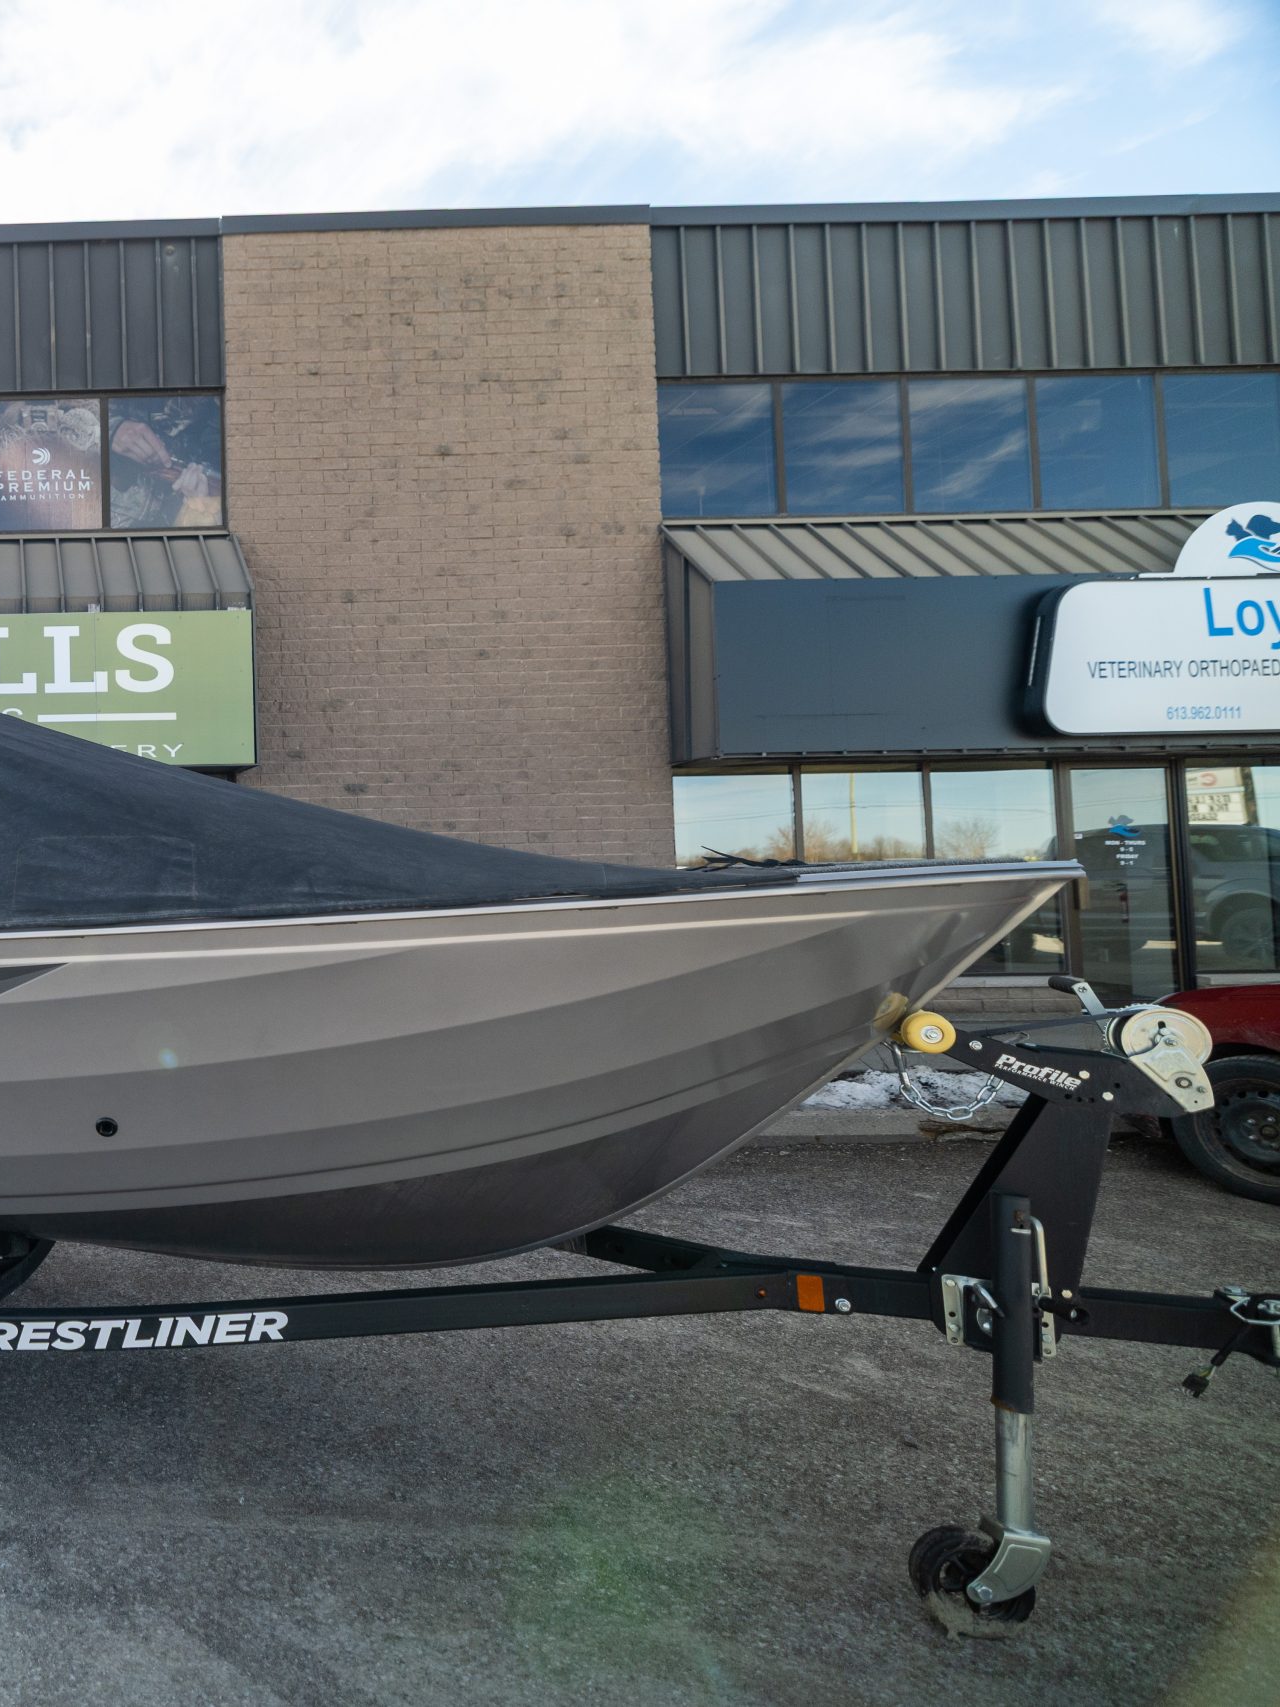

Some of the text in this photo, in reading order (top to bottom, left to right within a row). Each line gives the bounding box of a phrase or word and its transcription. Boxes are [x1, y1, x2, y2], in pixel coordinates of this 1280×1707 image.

[0, 493, 85, 502] AMMUNITION
[1087, 660, 1183, 679] VETERINARY
[1166, 706, 1242, 720] 613.962.0111
[994, 1063, 1076, 1092] PERFORMANCE WINCH
[995, 1053, 1082, 1088] Profile
